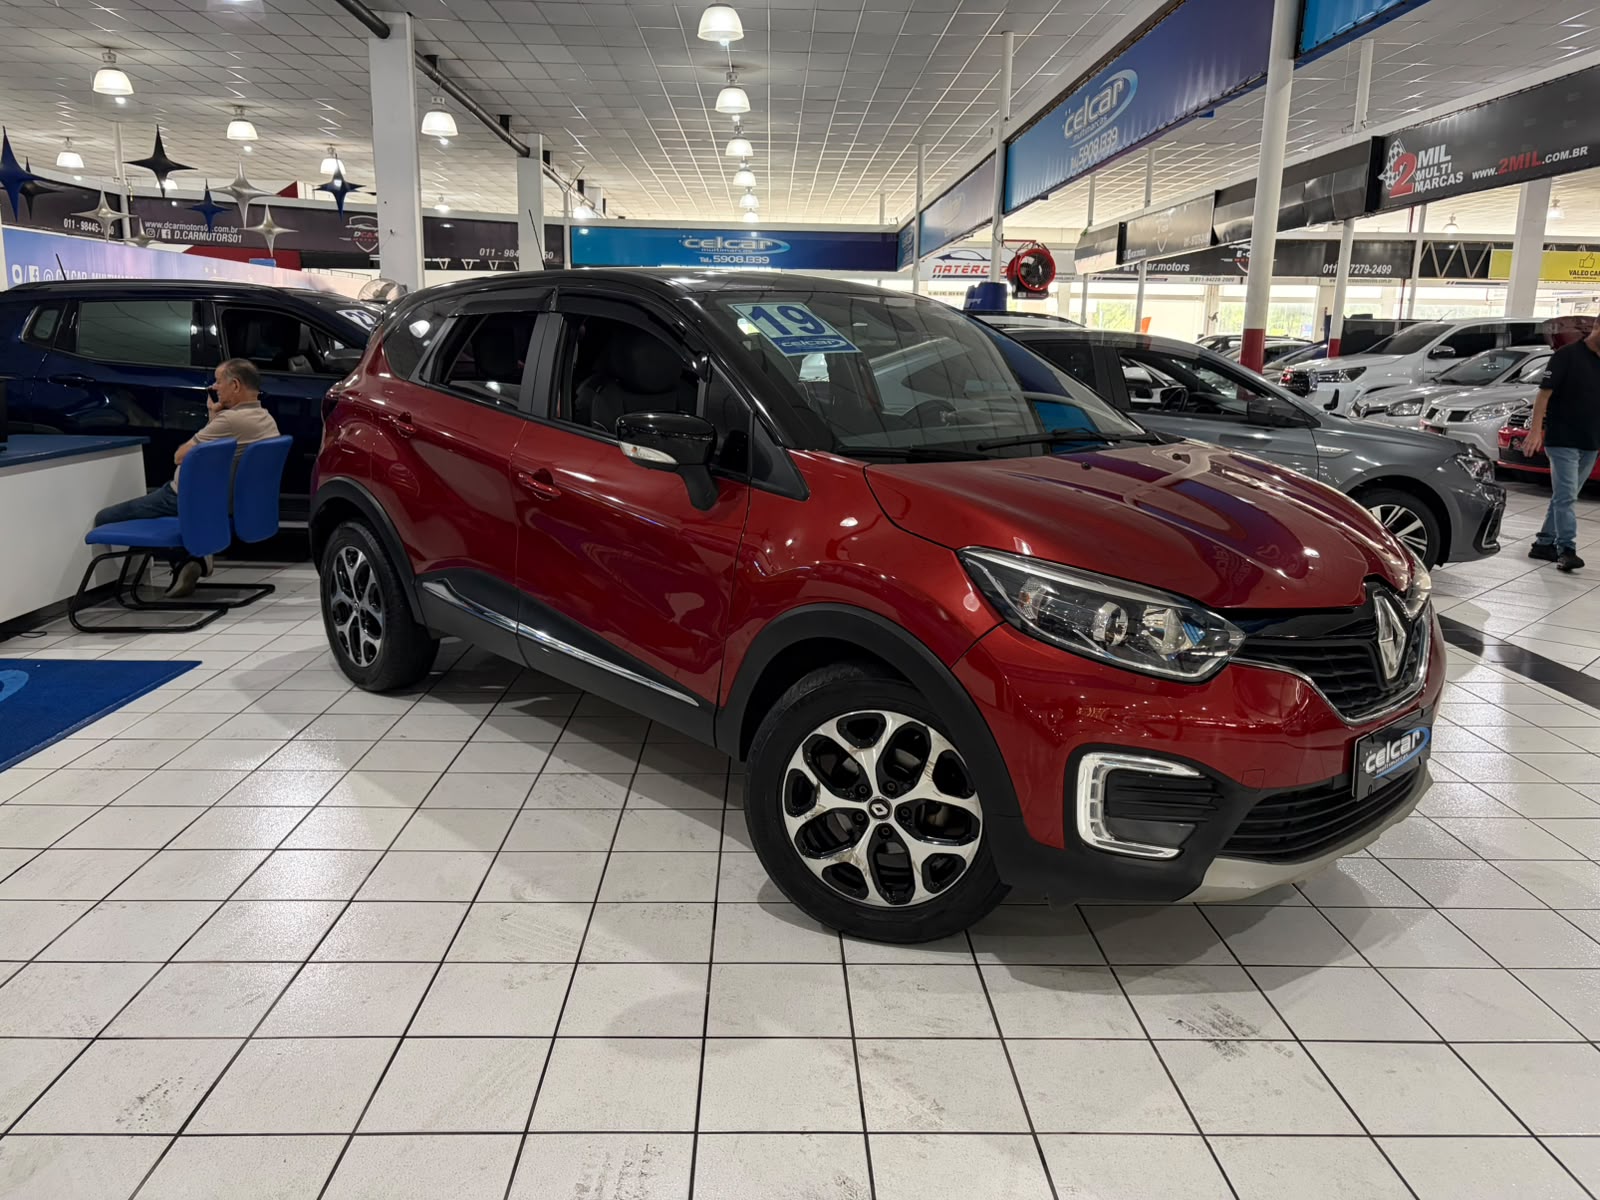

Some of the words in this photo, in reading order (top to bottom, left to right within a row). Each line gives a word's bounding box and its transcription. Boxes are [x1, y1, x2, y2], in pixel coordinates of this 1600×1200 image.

[1063, 79, 1126, 139] celcar
[1417, 144, 1452, 169] MIL
[1415, 162, 1452, 181] MULTI
[1414, 171, 1464, 194] MARCAS
[63, 218, 75, 229] 011
[144, 221, 239, 233] www.dcarmotors0.com.br
[681, 236, 774, 250] celcar
[480, 247, 496, 256] 011
[933, 263, 1009, 274] NATÉRCO
[1322, 263, 1338, 274] 011
[750, 305, 826, 336] 19
[781, 339, 836, 348] celcar
[1365, 730, 1420, 774] celcar
